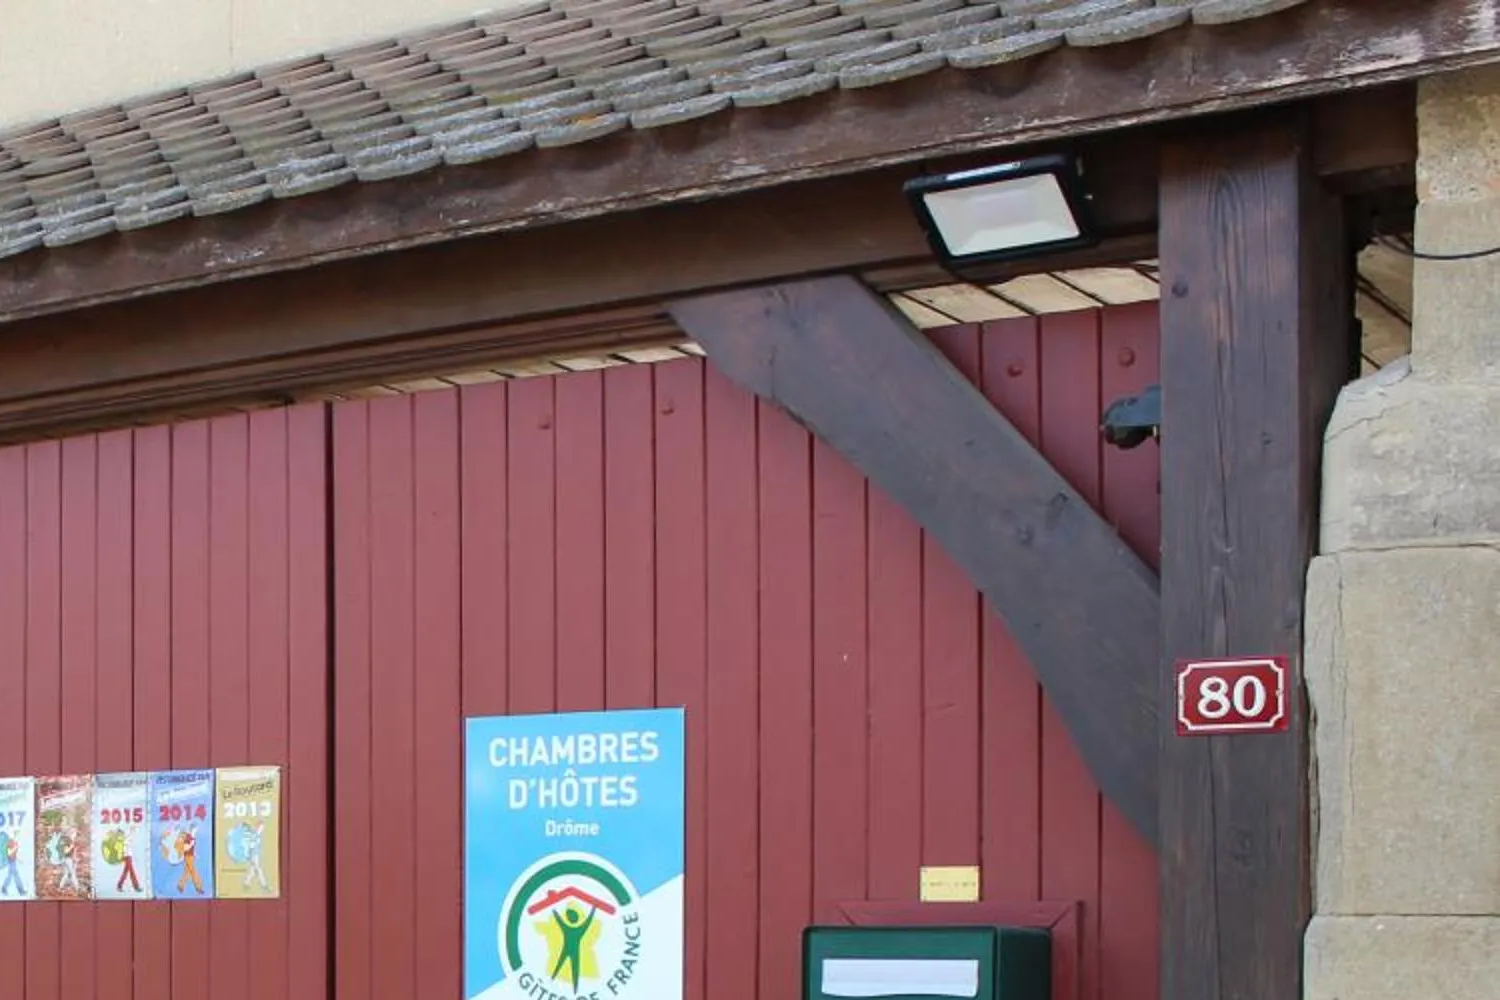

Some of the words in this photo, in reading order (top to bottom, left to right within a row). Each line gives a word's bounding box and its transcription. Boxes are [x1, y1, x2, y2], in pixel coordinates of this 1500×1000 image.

[1198, 675, 1266, 718] 80
[488, 732, 660, 767] CHAMBRES
[508, 768, 639, 809] D'HÔTES
[100, 808, 144, 824] 2015
[159, 804, 207, 821] 2014
[223, 801, 271, 817] 2013
[545, 819, 600, 837] Drôme
[606, 911, 641, 996] FRANCE
